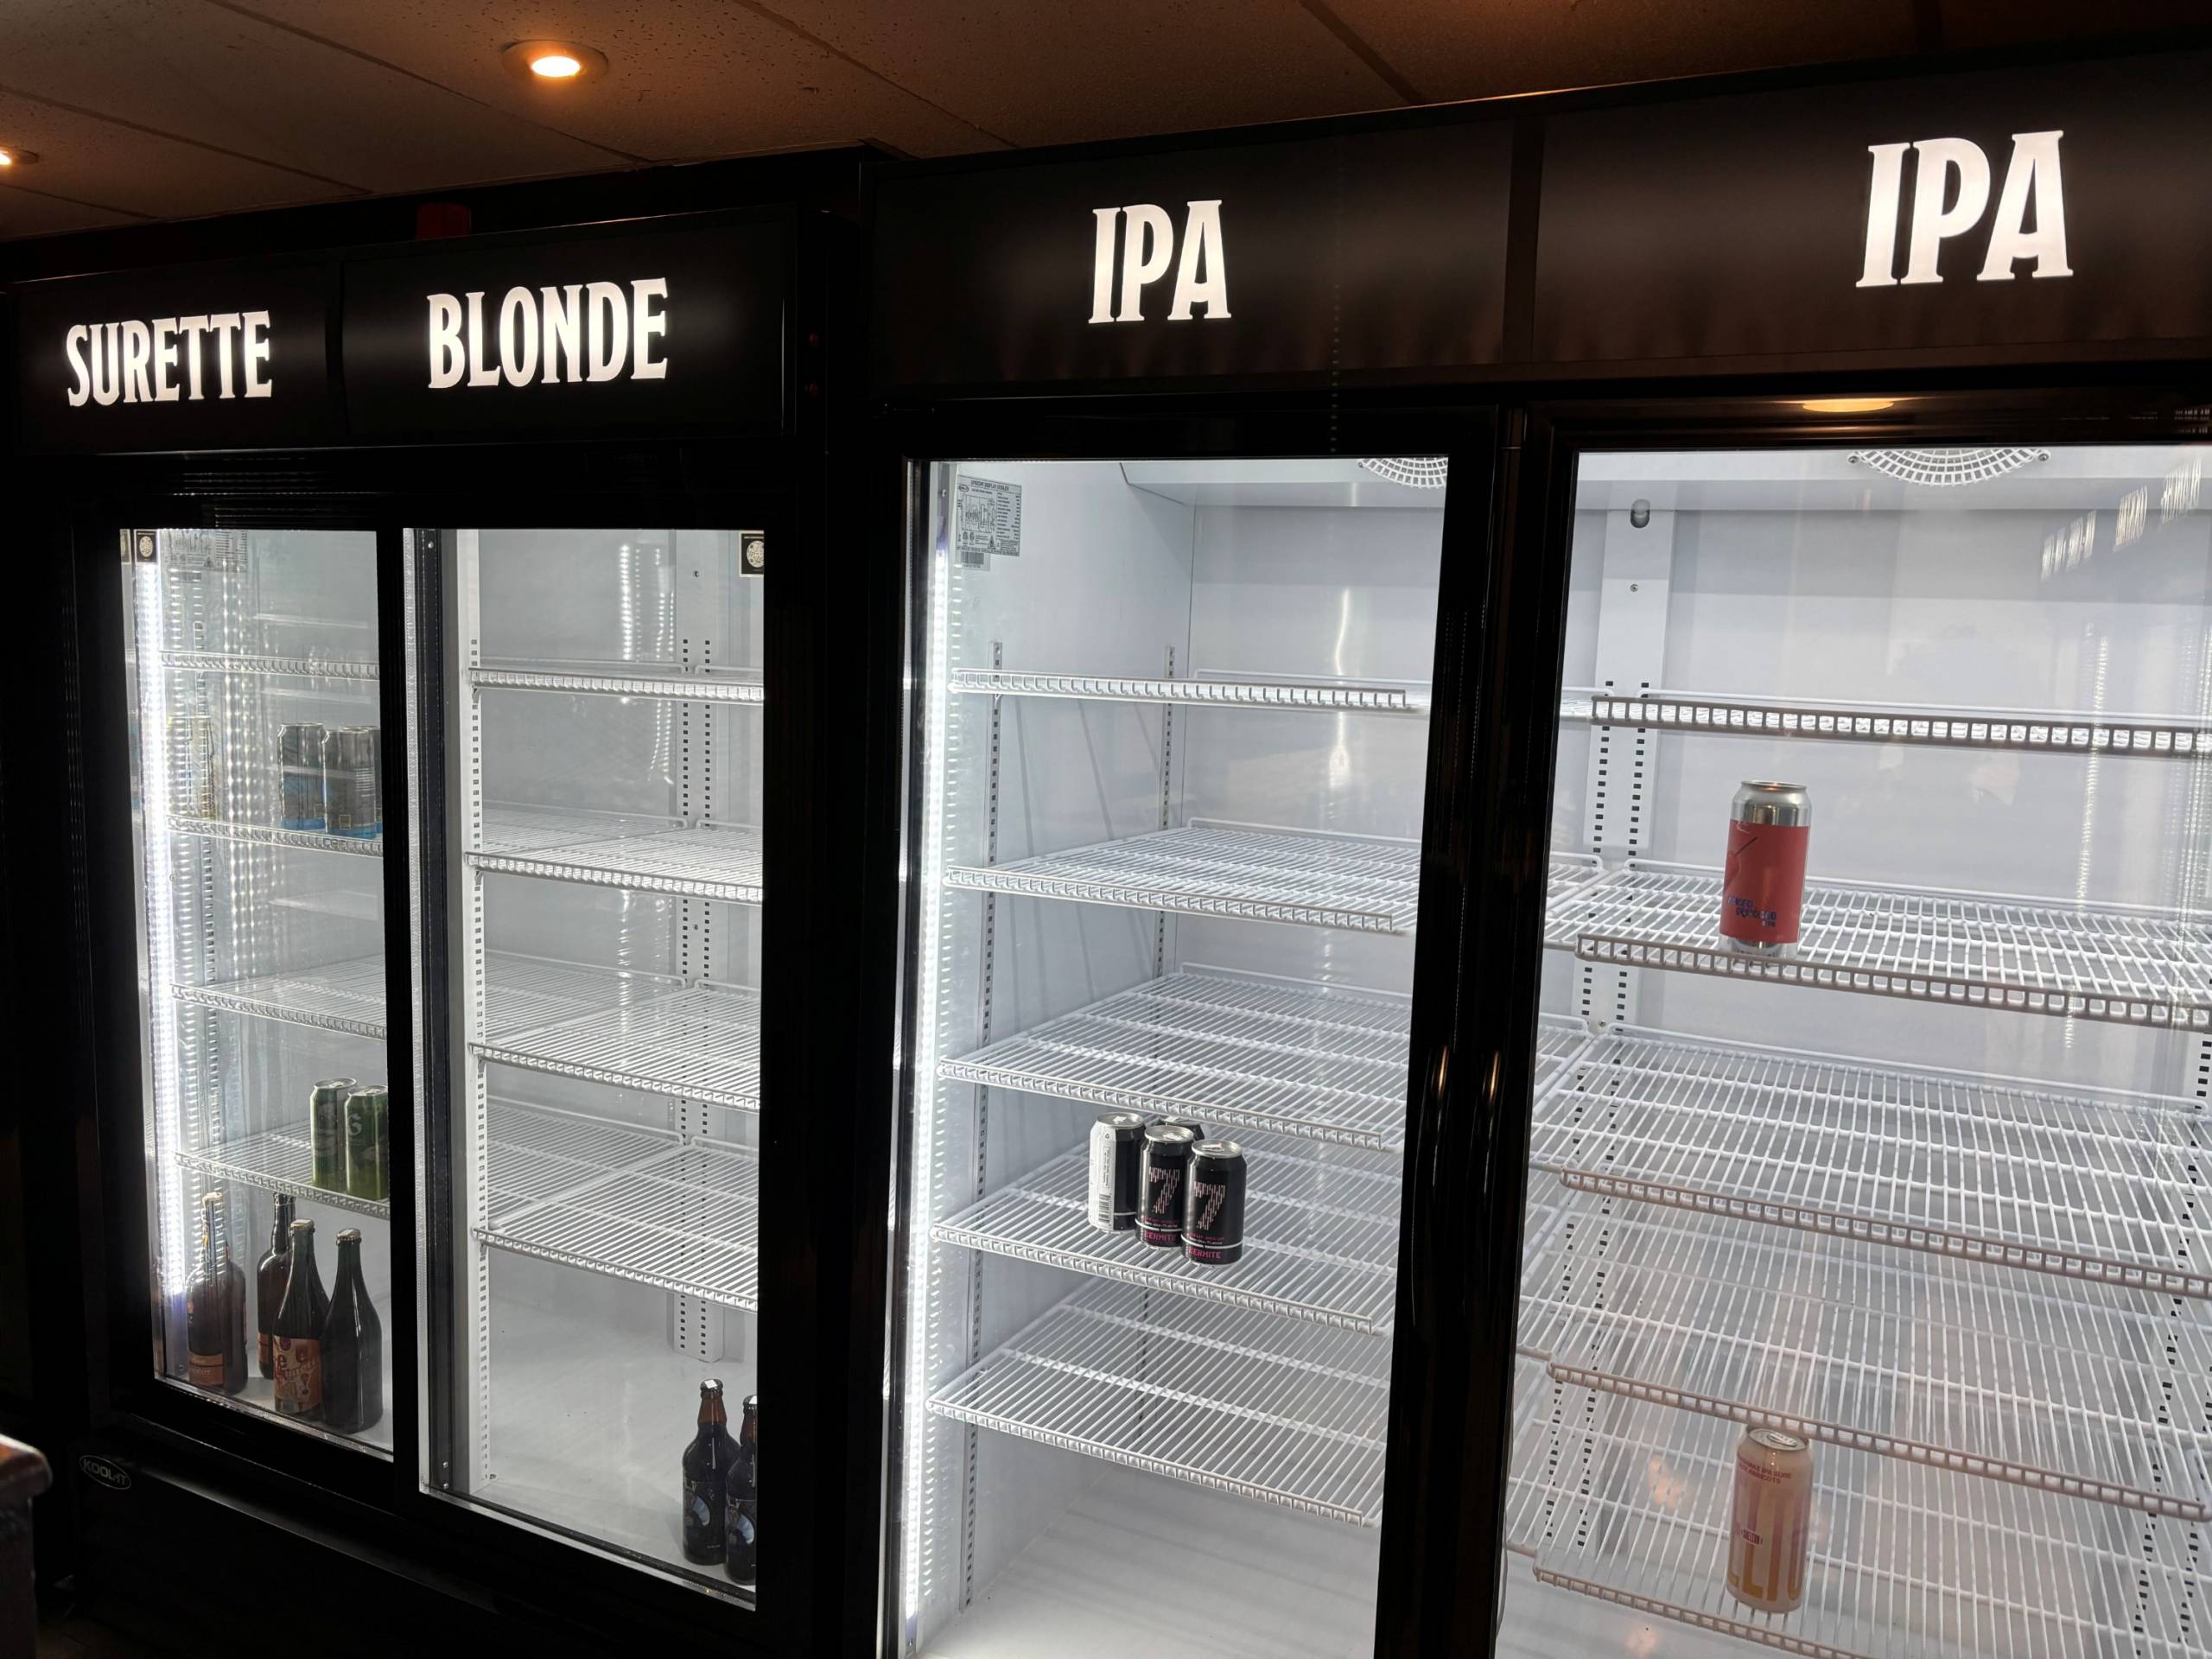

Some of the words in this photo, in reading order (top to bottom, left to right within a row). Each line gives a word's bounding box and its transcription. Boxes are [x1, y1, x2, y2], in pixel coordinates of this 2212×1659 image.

[1088, 200, 1232, 324] IPA
[1855, 130, 2074, 288] IPA
[66, 310, 272, 407] SURETTE
[427, 277, 668, 389] BLONDE
